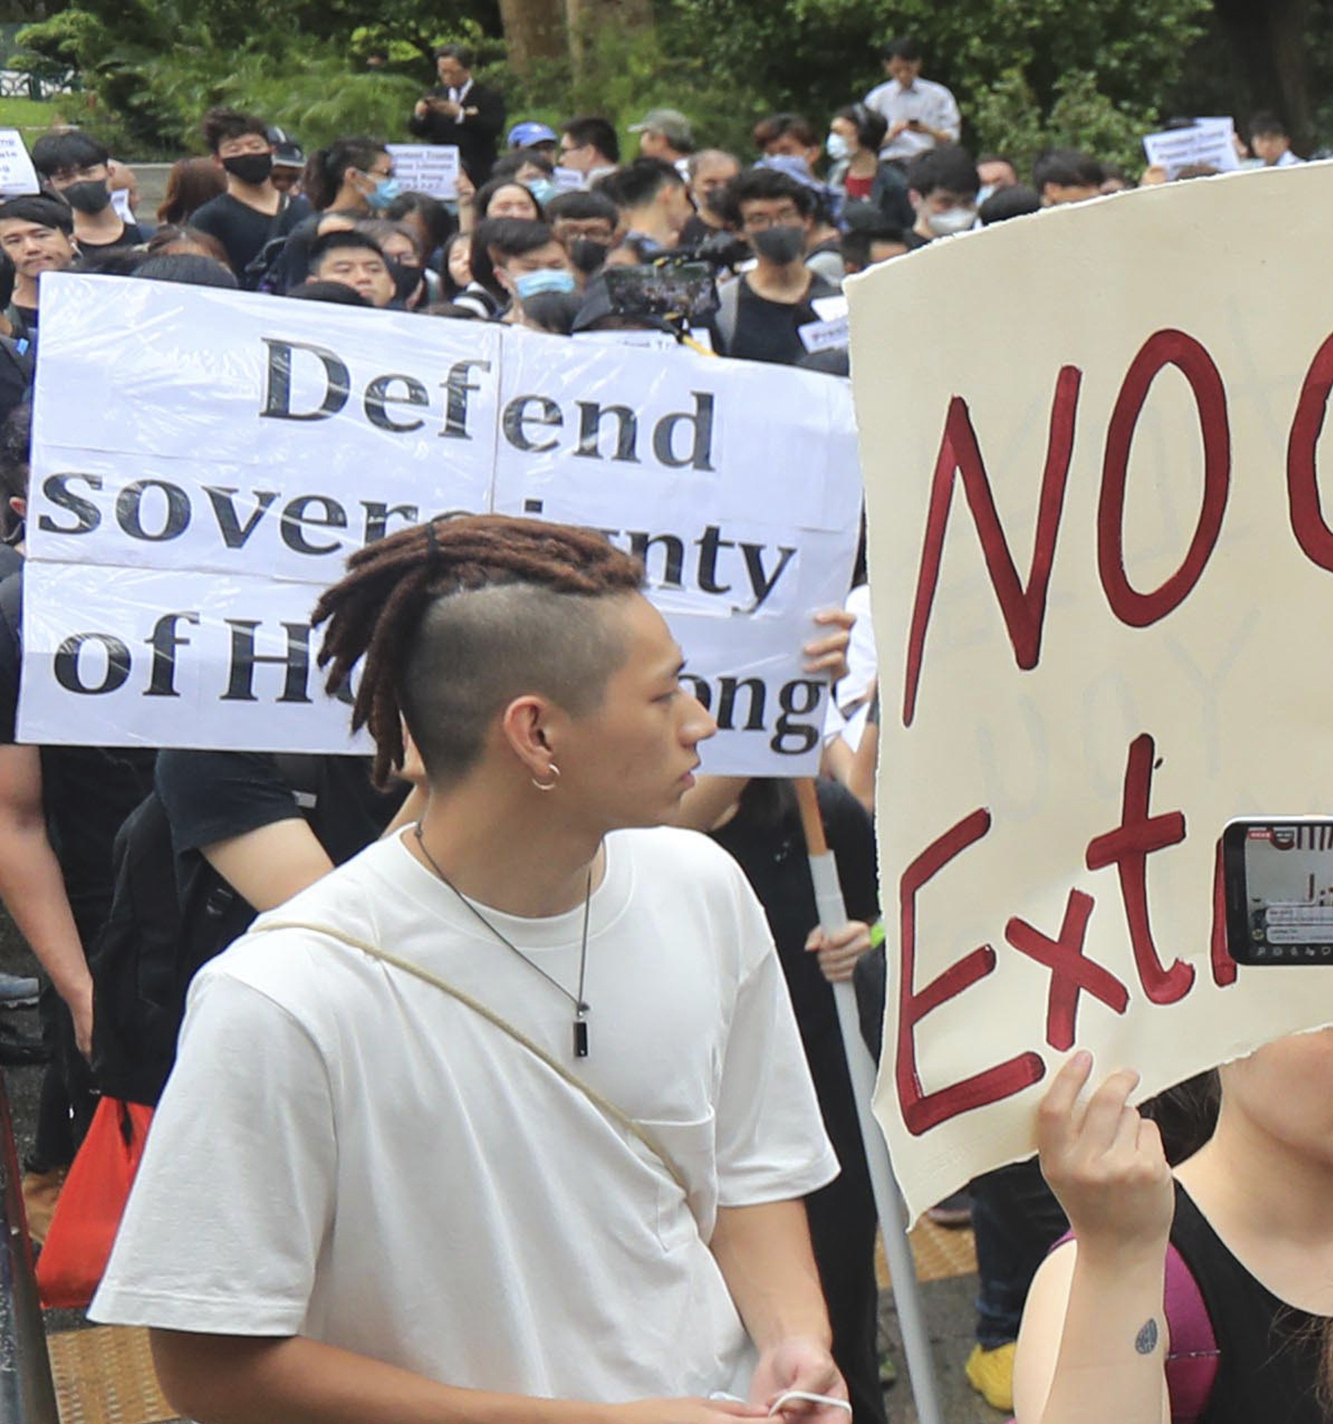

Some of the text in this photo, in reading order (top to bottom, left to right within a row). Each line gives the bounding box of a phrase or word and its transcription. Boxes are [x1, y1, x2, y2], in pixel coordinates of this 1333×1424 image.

[260, 337, 716, 473] Defend
[38, 471, 797, 615] sovernty
[903, 327, 1231, 729] NO
[53, 611, 200, 698] of
